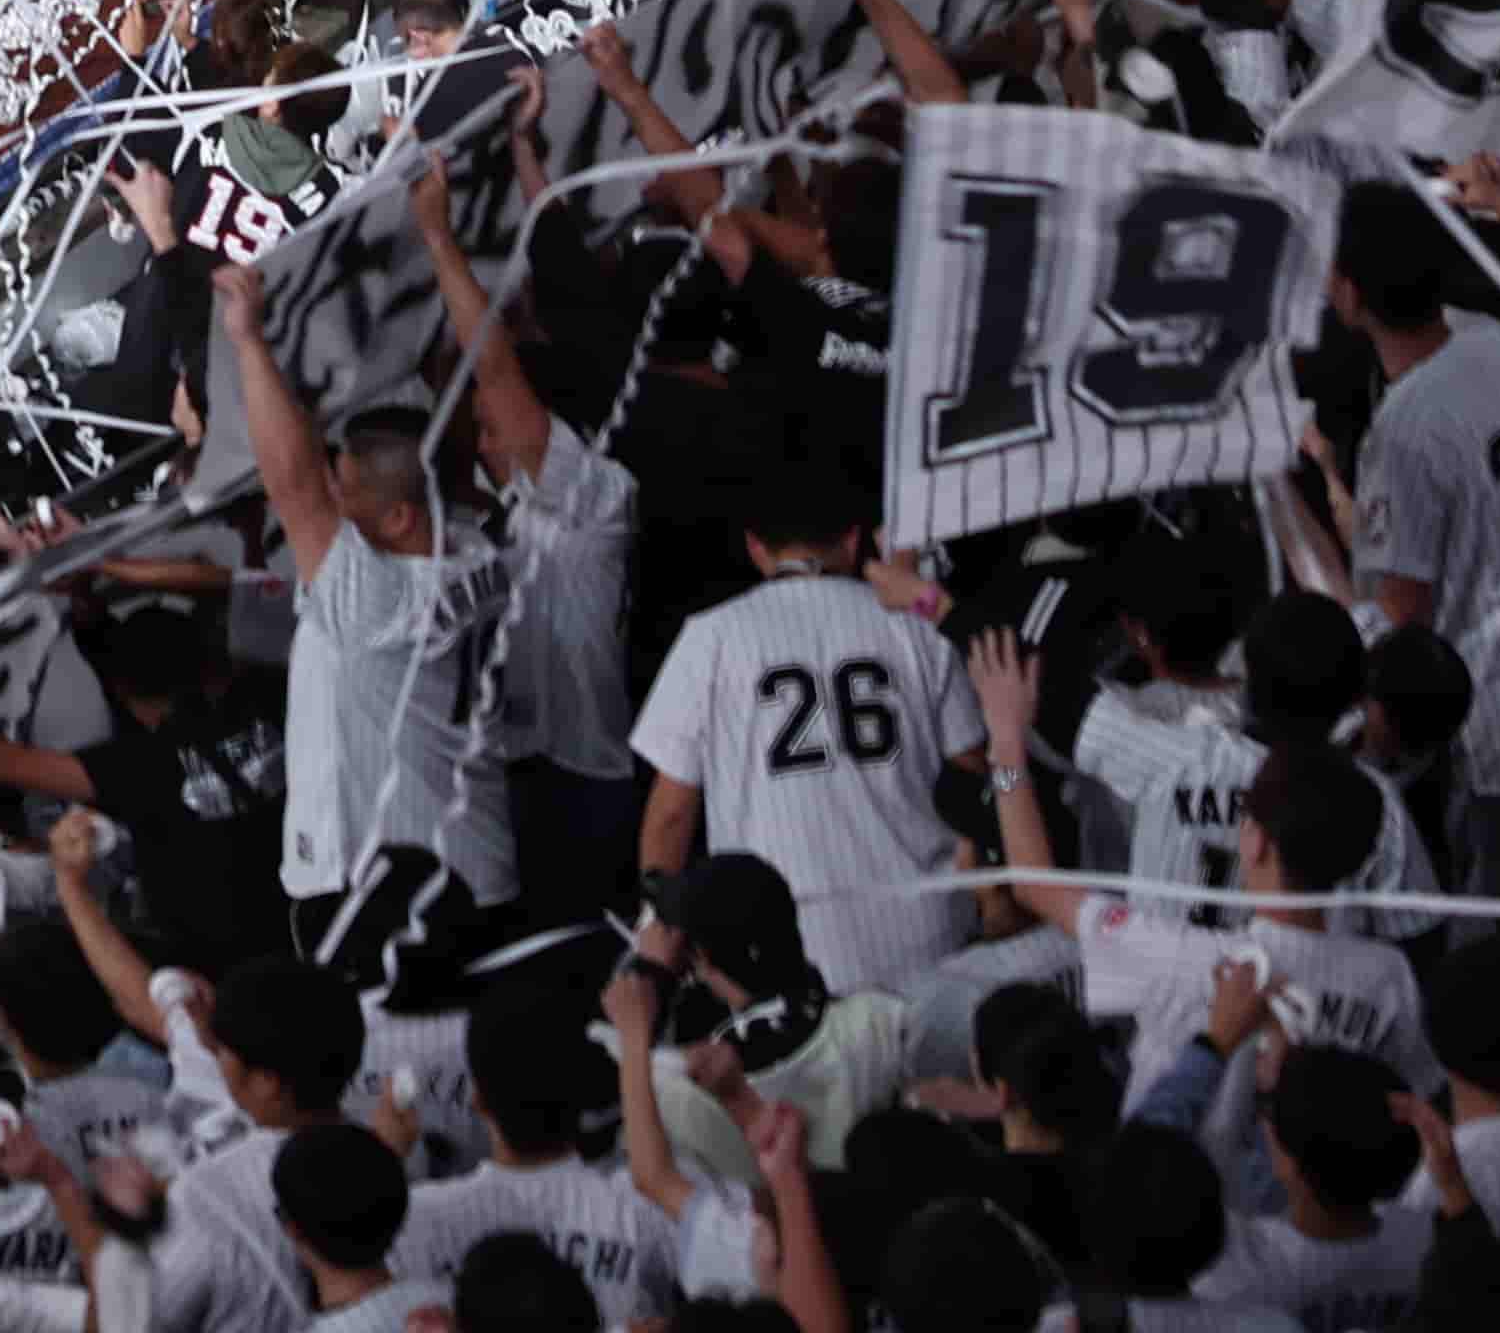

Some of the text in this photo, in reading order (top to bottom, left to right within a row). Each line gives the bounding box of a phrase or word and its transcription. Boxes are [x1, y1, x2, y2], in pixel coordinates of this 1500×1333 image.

[186, 171, 286, 266] 19
[924, 172, 1298, 467] 19
[757, 657, 902, 776] 26
